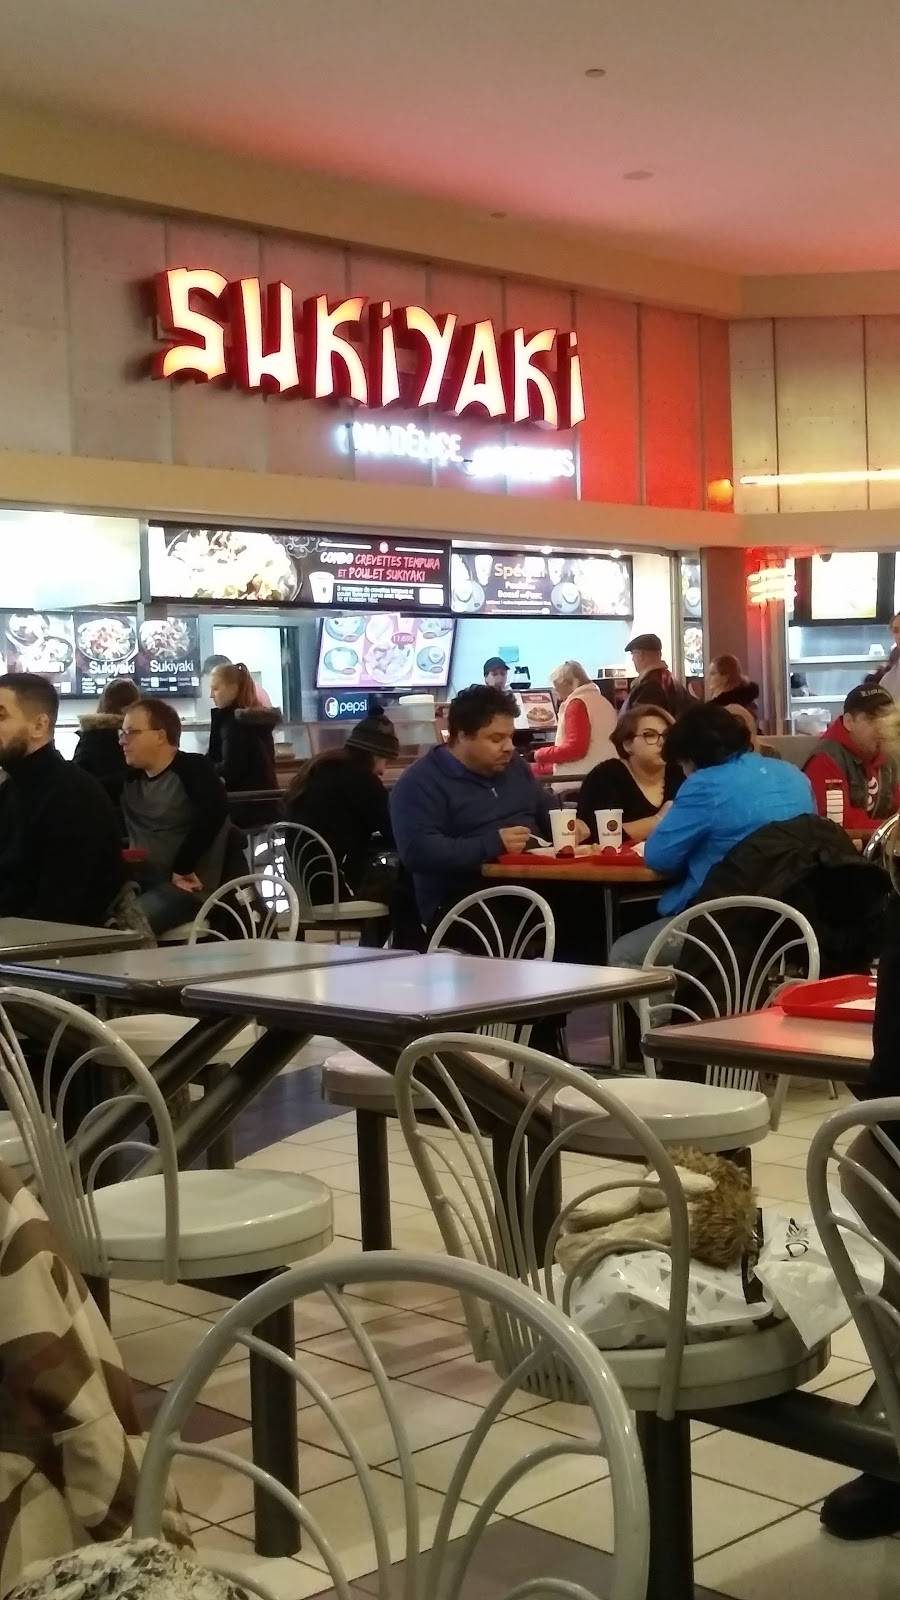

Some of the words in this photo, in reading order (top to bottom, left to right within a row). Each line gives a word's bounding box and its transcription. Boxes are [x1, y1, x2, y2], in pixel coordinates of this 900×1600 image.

[355, 553, 402, 568] CREVETTES
[404, 556, 441, 570] TEMPURA
[338, 569, 348, 578] ET
[348, 567, 385, 580] POULET
[386, 569, 426, 582] SUKIYAKI
[88, 660, 136, 677] Sukiyaki
[150, 659, 195, 675] Sukiyaki
[340, 699, 368, 714] pepsi
